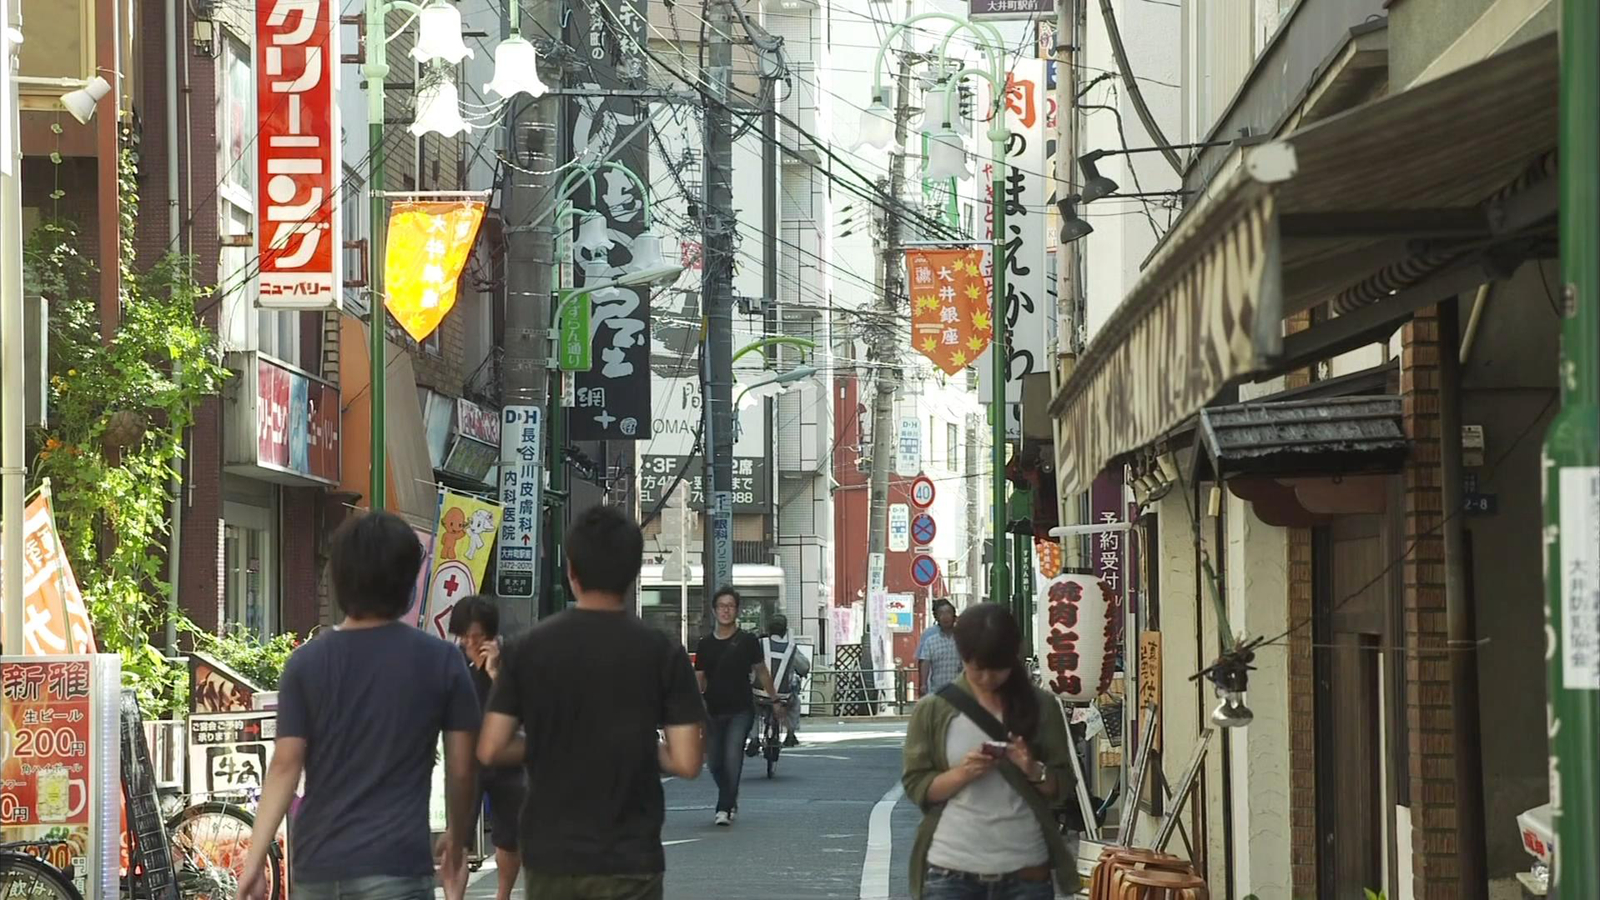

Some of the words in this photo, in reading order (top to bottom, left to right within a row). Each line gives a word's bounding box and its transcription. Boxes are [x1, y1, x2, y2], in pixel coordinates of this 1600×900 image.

[265, 0, 330, 269] クリーニング
[260, 282, 331, 297] ニューバリー
[938, 266, 960, 345] 大井銀座
[518, 427, 535, 534] 長谷川皮膚科
[916, 486, 930, 500] 40
[502, 470, 517, 541] 内科医院
[3, 662, 90, 700] 新雅
[23, 708, 84, 724] 生ビール
[13, 727, 86, 757] 200円
[214, 756, 260, 786] 牛角
